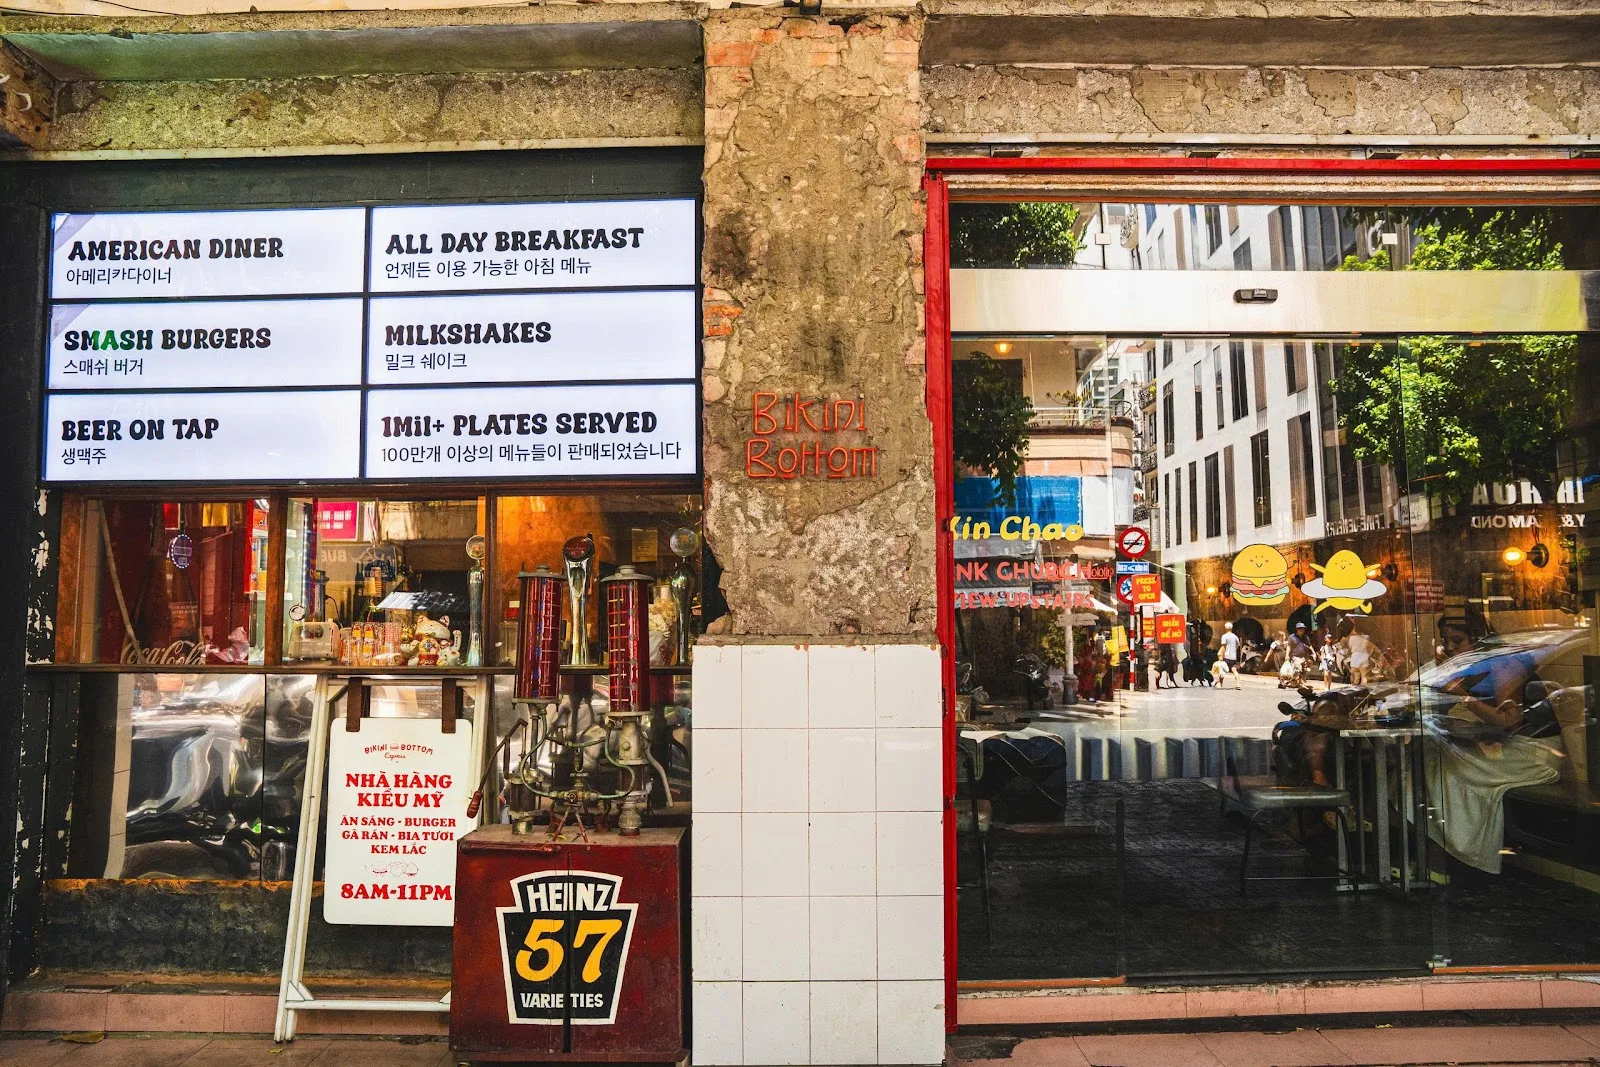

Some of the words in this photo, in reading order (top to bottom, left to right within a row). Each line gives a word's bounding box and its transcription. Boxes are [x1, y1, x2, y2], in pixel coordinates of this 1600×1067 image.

[68, 239, 200, 261] AMERICAN
[209, 238, 283, 259] DINER
[386, 234, 432, 254] ALL
[441, 232, 488, 253] DAY
[495, 228, 644, 252] BREAKFAST
[67, 267, 171, 285] 아메리카다이너
[386, 262, 430, 278] 언제든
[437, 261, 466, 277] 이용
[473, 259, 519, 276] 가능한
[525, 258, 553, 275] 아침
[561, 258, 591, 274] 메뉴
[65, 330, 153, 351] SMASH
[161, 328, 270, 350] BURGERS
[385, 322, 551, 346] MILKSHAKES
[63, 359, 107, 375] 스매쉬
[115, 358, 142, 375] 버거
[386, 354, 415, 370] 밀크
[421, 353, 467, 369] 쉐이크
[62, 420, 122, 441] BEER
[129, 419, 164, 440] ON
[172, 419, 219, 439] TAP
[453, 414, 547, 436] PLATES
[556, 412, 657, 434] SERVED
[62, 448, 106, 464] 생맥주
[382, 446, 440, 462] 100만개
[447, 445, 492, 462] 이상의
[500, 444, 561, 461] 메뉴들이
[568, 442, 681, 460] 판매되었습니다
[747, 438, 877, 478] Bottom
[1000, 516, 1084, 542] Chao
[955, 561, 989, 581] NK
[996, 561, 1093, 581] CHURCH
[1005, 592, 1096, 611] UPSTAIRS
[1138, 592, 1156, 600] OPEN
[364, 743, 388, 754] BIKINI
[401, 743, 434, 755] BOTTOM
[384, 752, 406, 761] Express
[345, 771, 389, 788] NHÀ
[393, 771, 453, 789] HÀNG
[357, 788, 408, 807] KIỂU
[412, 791, 444, 808] MỸ
[361, 815, 395, 827] SÁNG
[404, 817, 456, 828] BURGER
[341, 829, 359, 841] GÀ
[361, 829, 388, 841] RÁN
[398, 831, 420, 841] BIA
[422, 830, 454, 842] TƯƠI
[371, 844, 399, 855] KEM
[341, 883, 452, 901] 8AM-11PM
[527, 882, 612, 912] HEINZ
[516, 920, 622, 982] 57
